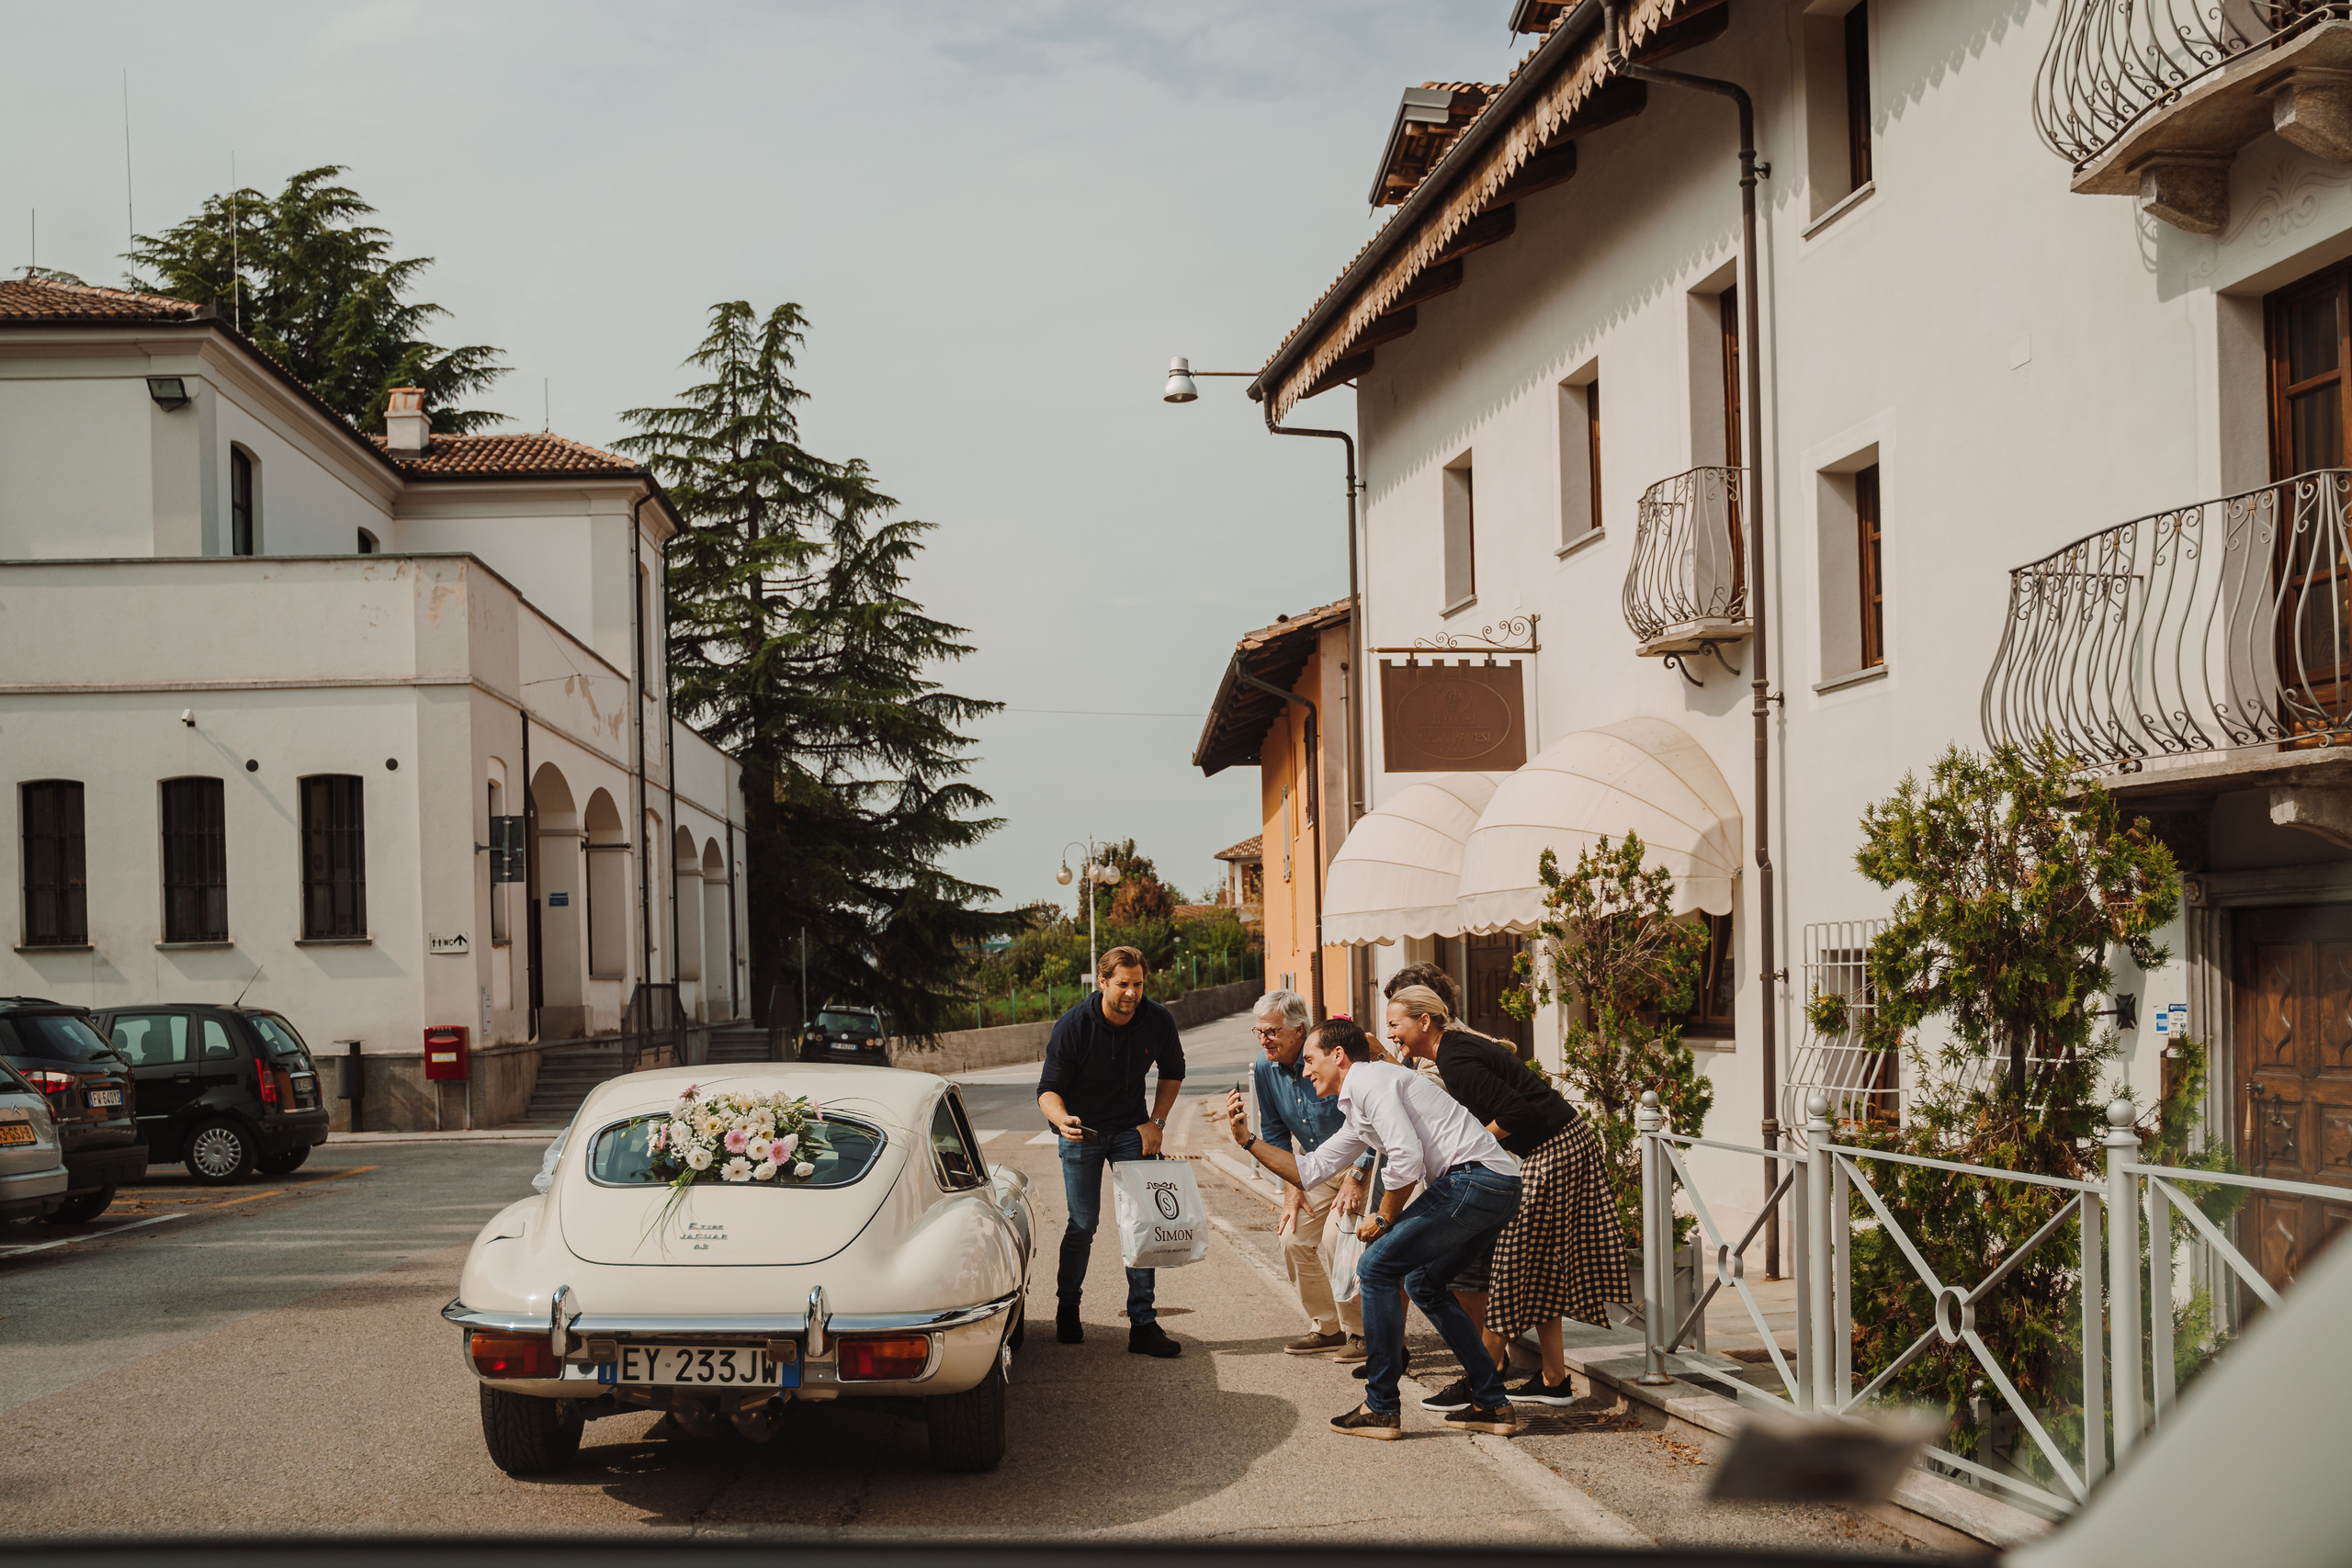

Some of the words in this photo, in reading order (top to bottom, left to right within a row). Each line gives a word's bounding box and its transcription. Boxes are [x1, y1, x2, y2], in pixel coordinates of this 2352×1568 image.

[1432, 714, 1476, 724] Hotel
[1419, 732, 1450, 742] CASA
[1453, 732, 1491, 742] PAVESI
[444, 938, 454, 946] WC
[1154, 1226, 1193, 1242] SIMON
[622, 1347, 662, 1382] EY
[674, 1348, 777, 1384] 233JW
